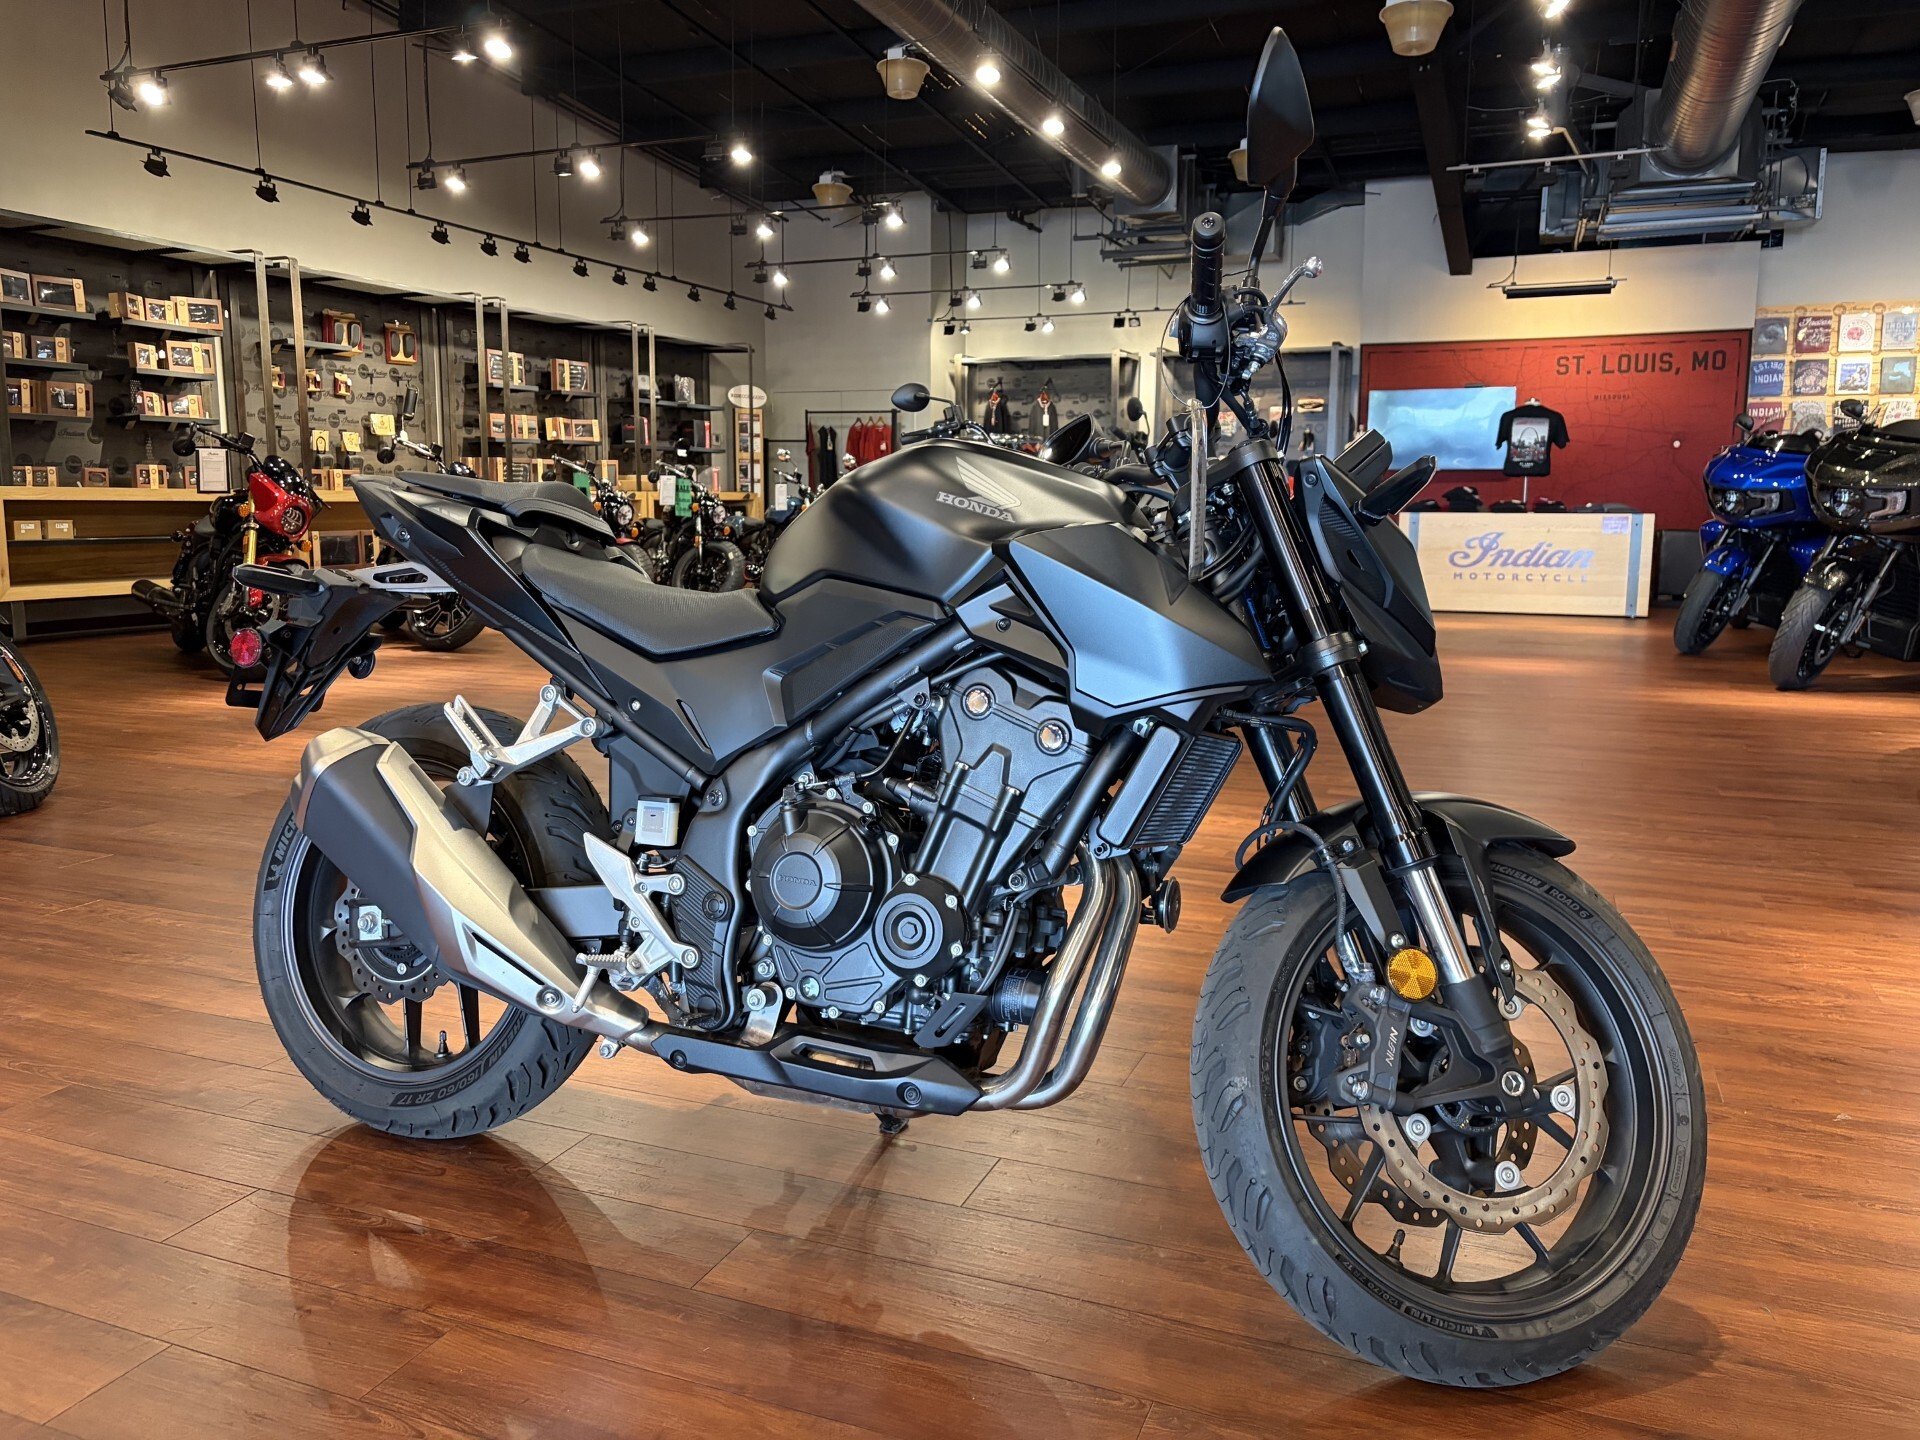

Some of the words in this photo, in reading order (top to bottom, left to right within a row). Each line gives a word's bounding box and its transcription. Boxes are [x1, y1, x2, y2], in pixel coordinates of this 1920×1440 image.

[1556, 355, 1592, 376] ST.
[1601, 352, 1681, 376] LOUIS,
[1691, 349, 1727, 371] MO
[1754, 373, 1785, 384] INDIAN
[936, 491, 1016, 524] HONDA
[1448, 531, 1595, 569] Indian
[1453, 571, 1588, 583] MOTORCYCLE
[779, 874, 818, 887] HONDA
[1549, 888, 1580, 912] ROAD
[1579, 910, 1590, 919] 6
[1385, 1026, 1399, 1067] NISSIN
[414, 1090, 435, 1104] ZR
[437, 1069, 480, 1099] 160/60
[397, 1093, 413, 1105] 17
[1367, 1281, 1400, 1308] 120/70
[1408, 1307, 1474, 1334] MICHELIN
